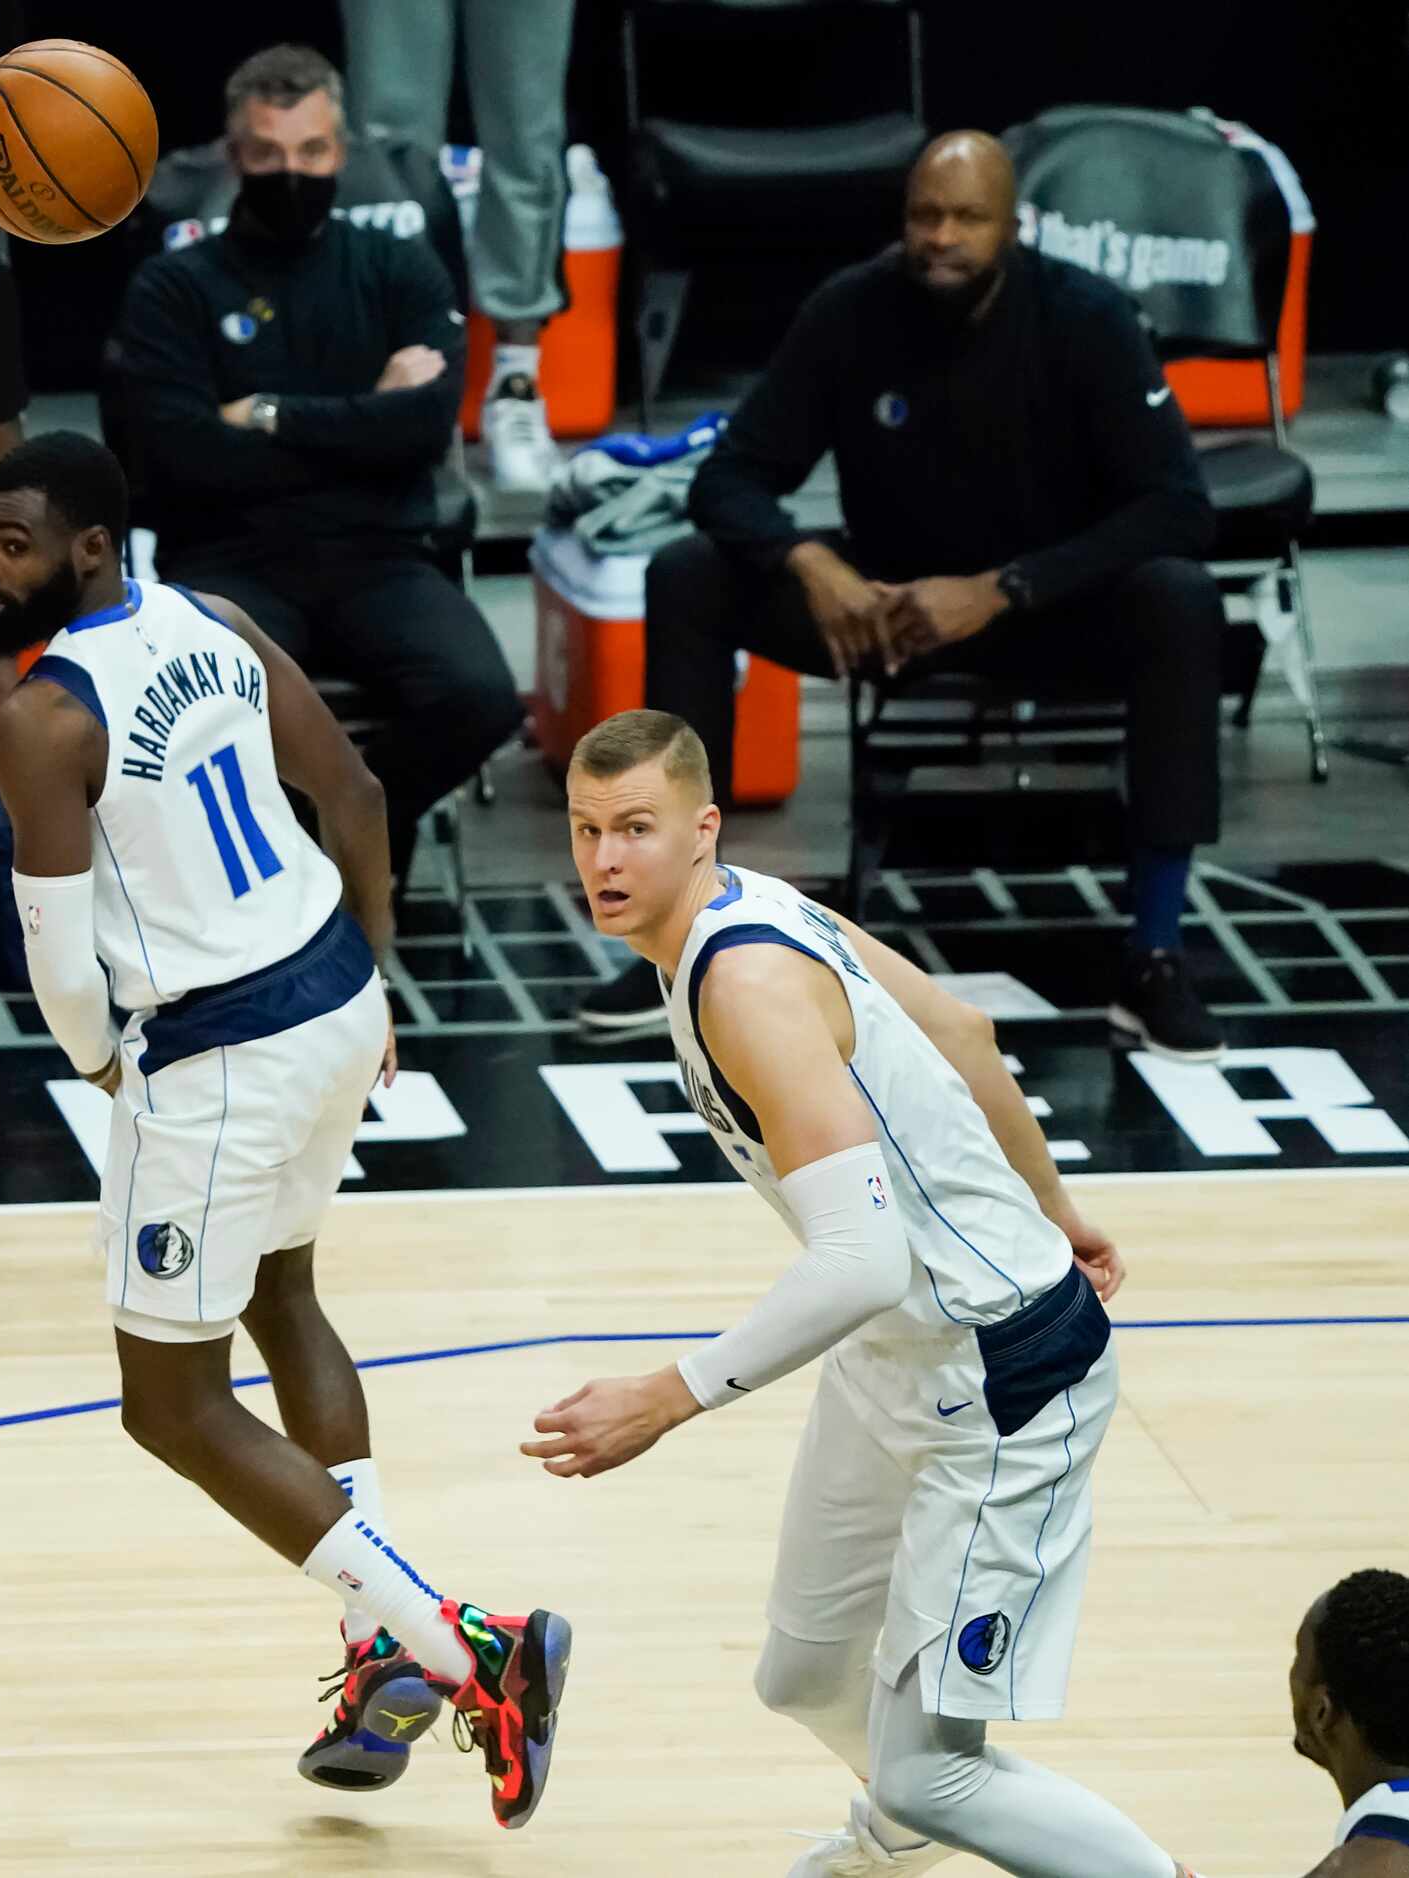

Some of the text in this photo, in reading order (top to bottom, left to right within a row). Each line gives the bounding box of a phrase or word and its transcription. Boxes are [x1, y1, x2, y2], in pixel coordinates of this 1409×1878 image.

[1127, 233, 1230, 290] game
[122, 651, 263, 782] HARDAWAY JR.
[184, 743, 284, 900] 11
